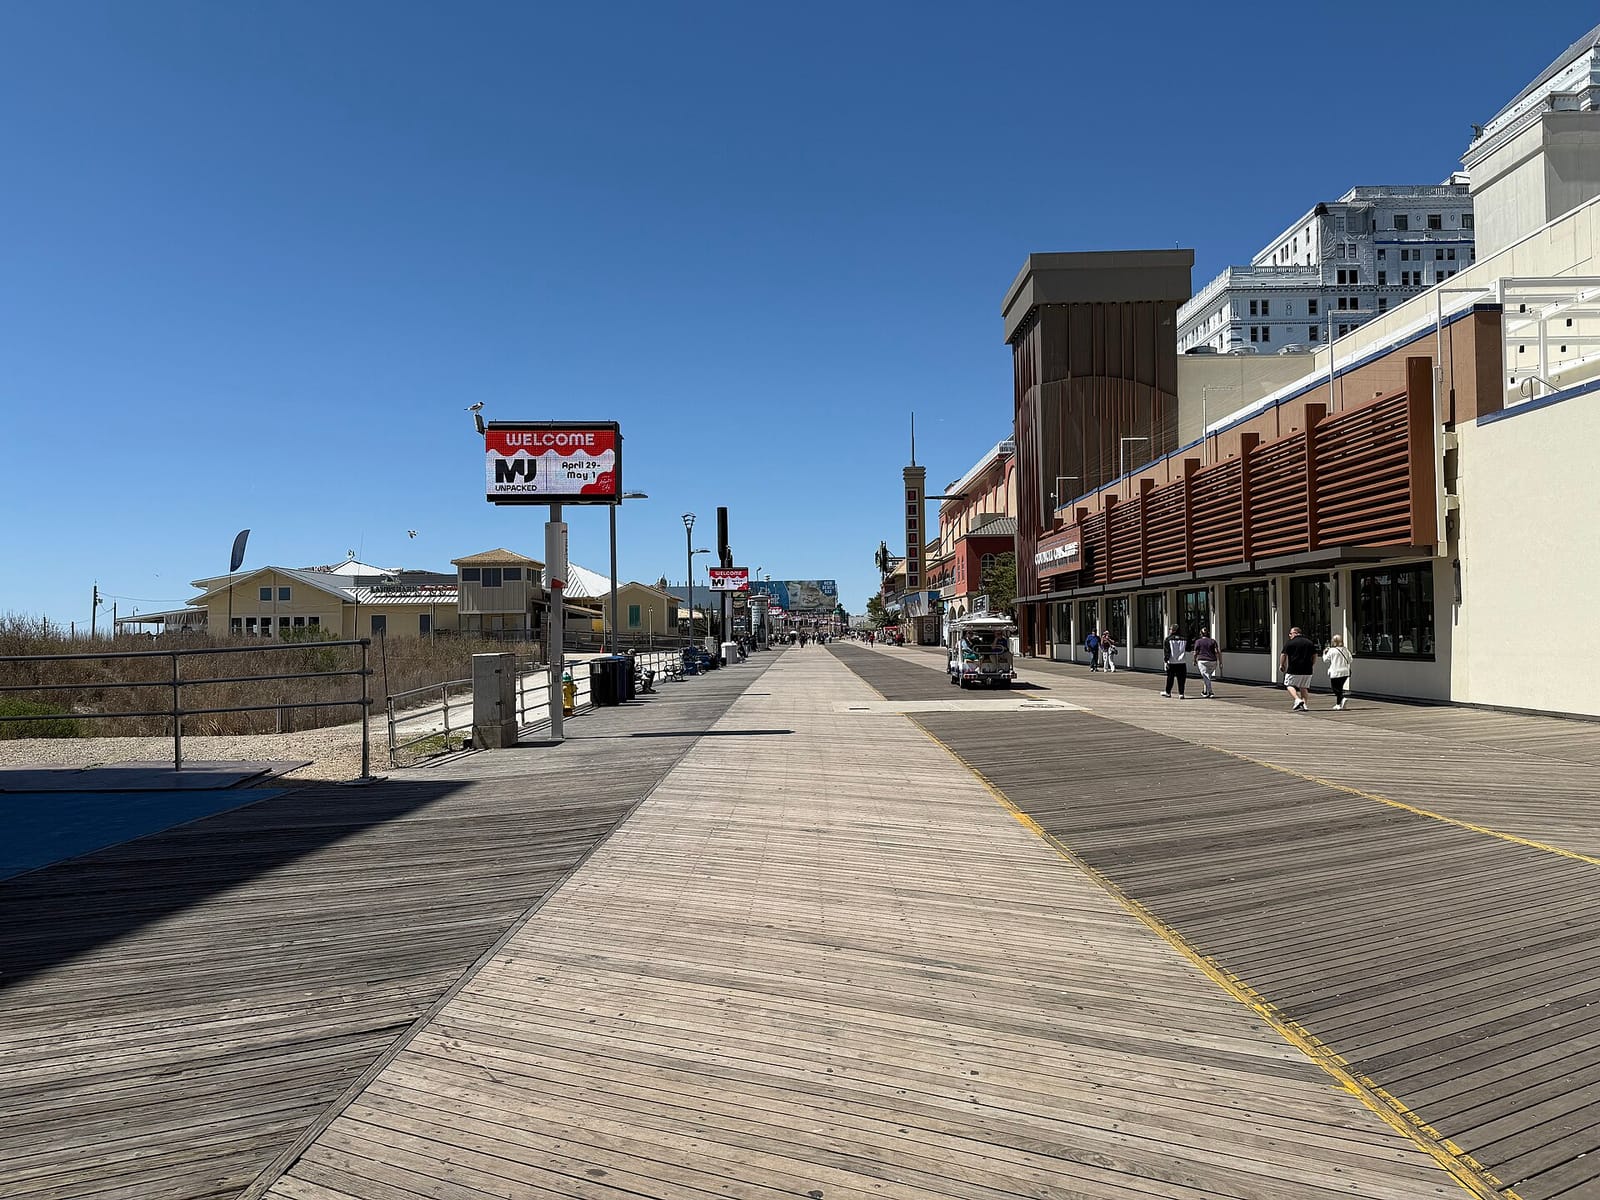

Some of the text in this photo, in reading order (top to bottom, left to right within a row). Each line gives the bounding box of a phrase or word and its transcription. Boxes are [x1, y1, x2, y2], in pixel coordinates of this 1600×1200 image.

[506, 433, 595, 446] WELCOME
[495, 459, 536, 483] MJ
[562, 461, 584, 471] April
[567, 472, 588, 481] May
[495, 484, 537, 492] UNPACKED
